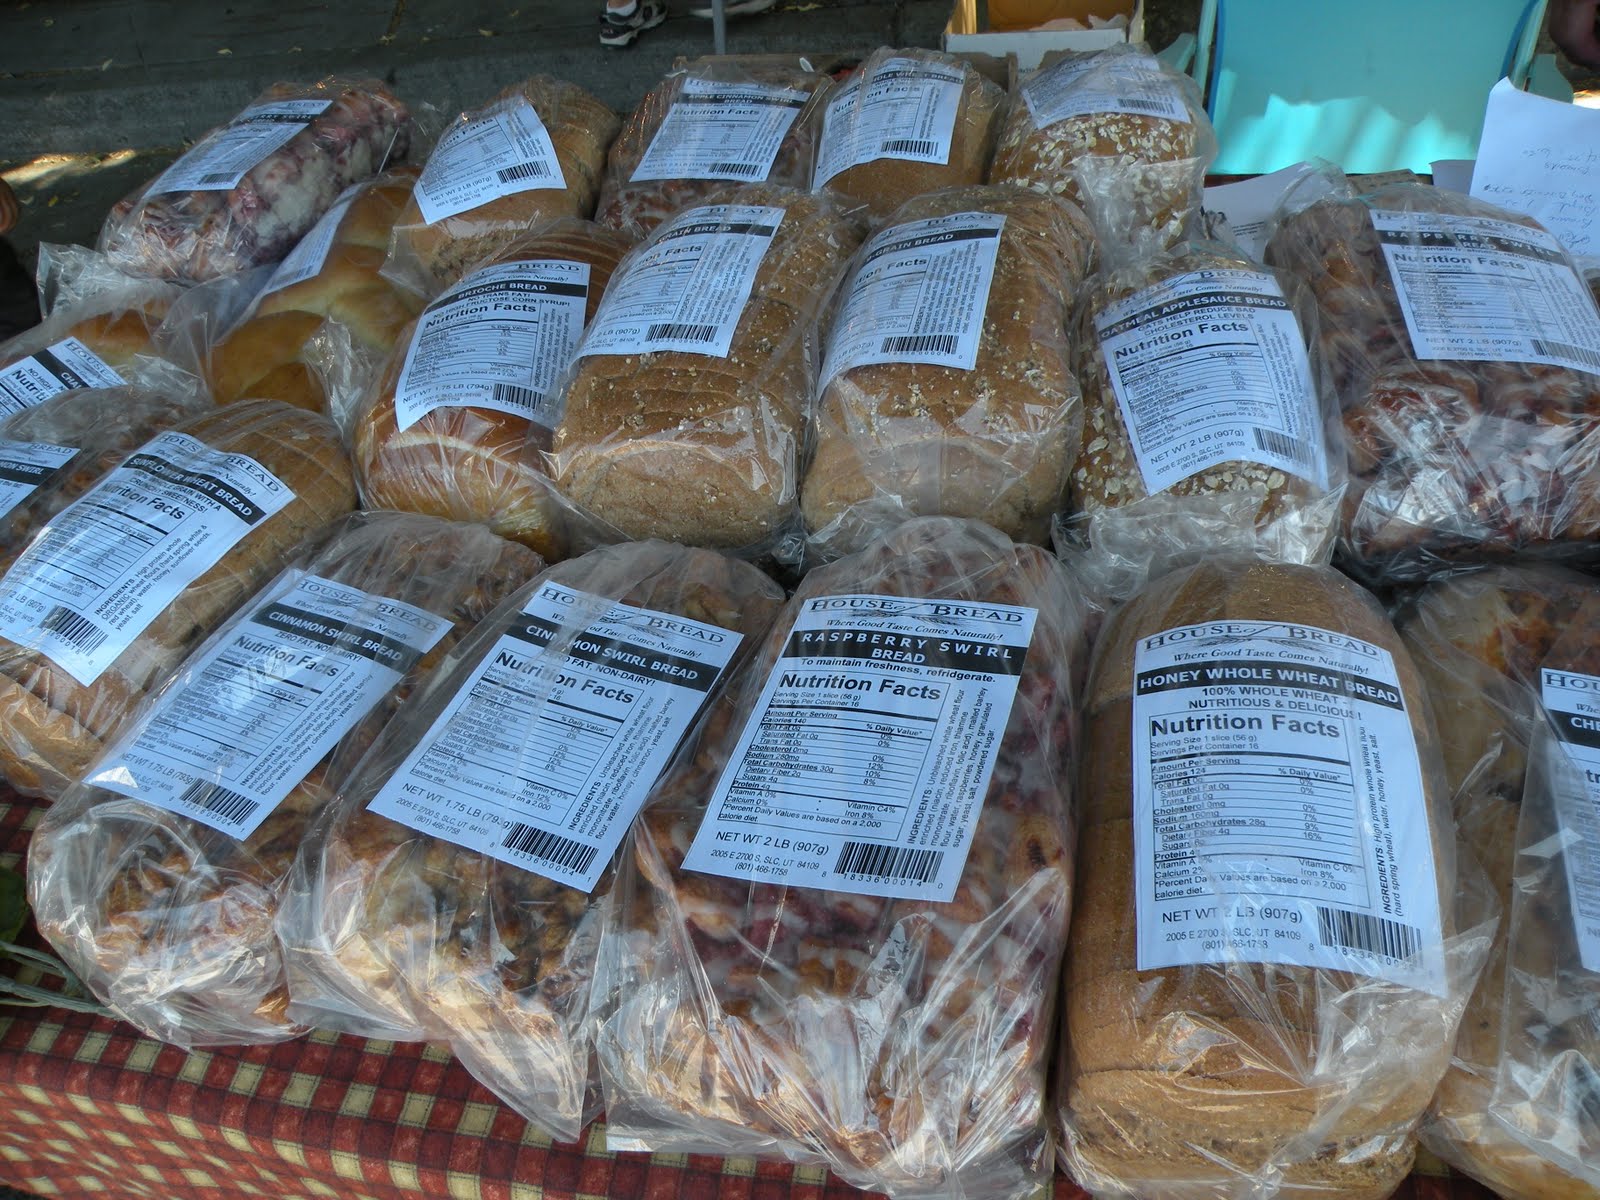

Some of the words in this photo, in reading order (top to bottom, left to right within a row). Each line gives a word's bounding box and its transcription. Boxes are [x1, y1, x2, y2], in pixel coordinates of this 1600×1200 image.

[665, 245, 702, 256] Facts
[917, 234, 953, 246] BREAD
[887, 258, 927, 270] Facts
[1477, 257, 1525, 270] Facts
[533, 274, 569, 282] Naturally!
[458, 284, 506, 299] BRIOCHE
[466, 297, 512, 307] FRUCTOSE
[540, 299, 570, 307] SYRUP!
[426, 305, 488, 328] Nutrition
[494, 303, 537, 312] Facts
[1101, 312, 1159, 338] OATMEAL
[1162, 296, 1243, 314] APPLESAUCE
[1245, 297, 1286, 308] BREAD
[1138, 319, 1164, 332] OATS
[1166, 313, 1192, 322] HELP
[1193, 307, 1233, 315] REDUCE
[1144, 314, 1215, 336] CHOLESTEROL
[1115, 328, 1197, 359] Nutrition
[1198, 321, 1249, 334] Facts
[1151, 452, 1169, 464] NET
[1172, 444, 1187, 454] WT
[1198, 435, 1211, 443] LB
[1214, 429, 1244, 439] (907g)
[226, 456, 280, 492] BREAD
[130, 458, 185, 482] SUNFLOWER
[184, 475, 218, 492] WHEAT
[215, 488, 253, 517] BREAD
[149, 497, 185, 520] Facts
[195, 492, 215, 508] WITH
[811, 599, 894, 611] HOUSE
[931, 603, 1023, 623] BREAD
[268, 611, 327, 632] CINNAMON
[324, 628, 365, 645] SWIRL
[362, 639, 403, 662] BREAD
[275, 631, 297, 641] ZERO
[647, 615, 727, 643] BREAD
[827, 619, 854, 627] Where
[857, 620, 884, 628] Good
[886, 621, 913, 632] Taste
[915, 625, 948, 635] Comes
[951, 628, 1003, 641] Naturally!
[1145, 624, 1242, 650] HOUSE
[1286, 627, 1379, 657] BREAD
[233, 634, 297, 663] Nutrition
[296, 655, 339, 677] Facts
[627, 633, 657, 647] Comes
[658, 640, 702, 658] Naturally!
[801, 632, 929, 649] RASPBERRY
[939, 641, 1012, 659] SWIRL
[871, 649, 926, 663] BREAD
[571, 658, 592, 671] FAT,
[596, 664, 656, 687] NON-DAIRY!
[601, 648, 647, 667] SWIRL
[650, 661, 699, 681] BREAD
[801, 658, 814, 666] To
[816, 658, 862, 667] maintain
[864, 659, 922, 675] freshness,
[926, 667, 996, 683] refridgerate.
[1174, 650, 1208, 662] Where
[1211, 649, 1241, 657] Good
[1245, 649, 1275, 657] Taste
[1278, 650, 1315, 661] Comes
[1318, 656, 1368, 674] Naturally!
[580, 680, 635, 704] Facts
[779, 673, 873, 692] Nutrition
[879, 678, 941, 700] Facts
[1140, 670, 1201, 689] HONEY
[1206, 668, 1272, 680] WHOLE
[1277, 669, 1340, 689] WHEAT
[1345, 681, 1399, 703] BREAD
[1202, 687, 1235, 696] 100%
[1238, 687, 1286, 698] WHOLE
[1293, 690, 1338, 703] WHEAT
[1188, 698, 1270, 709] NUTRITIOUS
[1275, 700, 1284, 708] &
[875, 724, 895, 733] Daily
[1151, 713, 1263, 737] Nutrition
[1271, 714, 1340, 738] Facts
[1205, 742, 1246, 750] Container
[1249, 742, 1259, 750] 16
[1289, 768, 1311, 777] Daily
[403, 782, 424, 795] NET
[426, 791, 443, 803] WT
[445, 799, 466, 812] 1.75
[467, 806, 482, 818] LB
[755, 806, 775, 816] Daily
[775, 809, 800, 819] Values
[816, 814, 839, 824] based
[859, 819, 881, 829] 2,000
[716, 831, 741, 843] NET
[742, 833, 763, 845] WT
[764, 836, 771, 847] 2
[774, 837, 790, 849] LB
[792, 841, 829, 856] (907g)
[710, 849, 728, 858] 2005
[729, 850, 735, 858] E
[736, 851, 754, 861] 2700
[754, 853, 762, 863] S,
[764, 855, 781, 866] SLC,
[782, 858, 793, 867] UT
[796, 859, 820, 870] 84109
[734, 862, 754, 872] (801)
[754, 864, 788, 876] 466-1758
[1271, 875, 1298, 885] based
[1322, 880, 1346, 891] 2,000
[1301, 868, 1317, 877] Iron
[1319, 870, 1334, 879] 8%
[1375, 843, 1392, 914] INGREDIENTS:
[1162, 910, 1191, 923] NET
[1194, 907, 1217, 920] WT
[1259, 908, 1303, 924] (907g)
[1166, 931, 1187, 942] 2005
[1197, 929, 1219, 939] 2700
[1274, 929, 1301, 940] 84109
